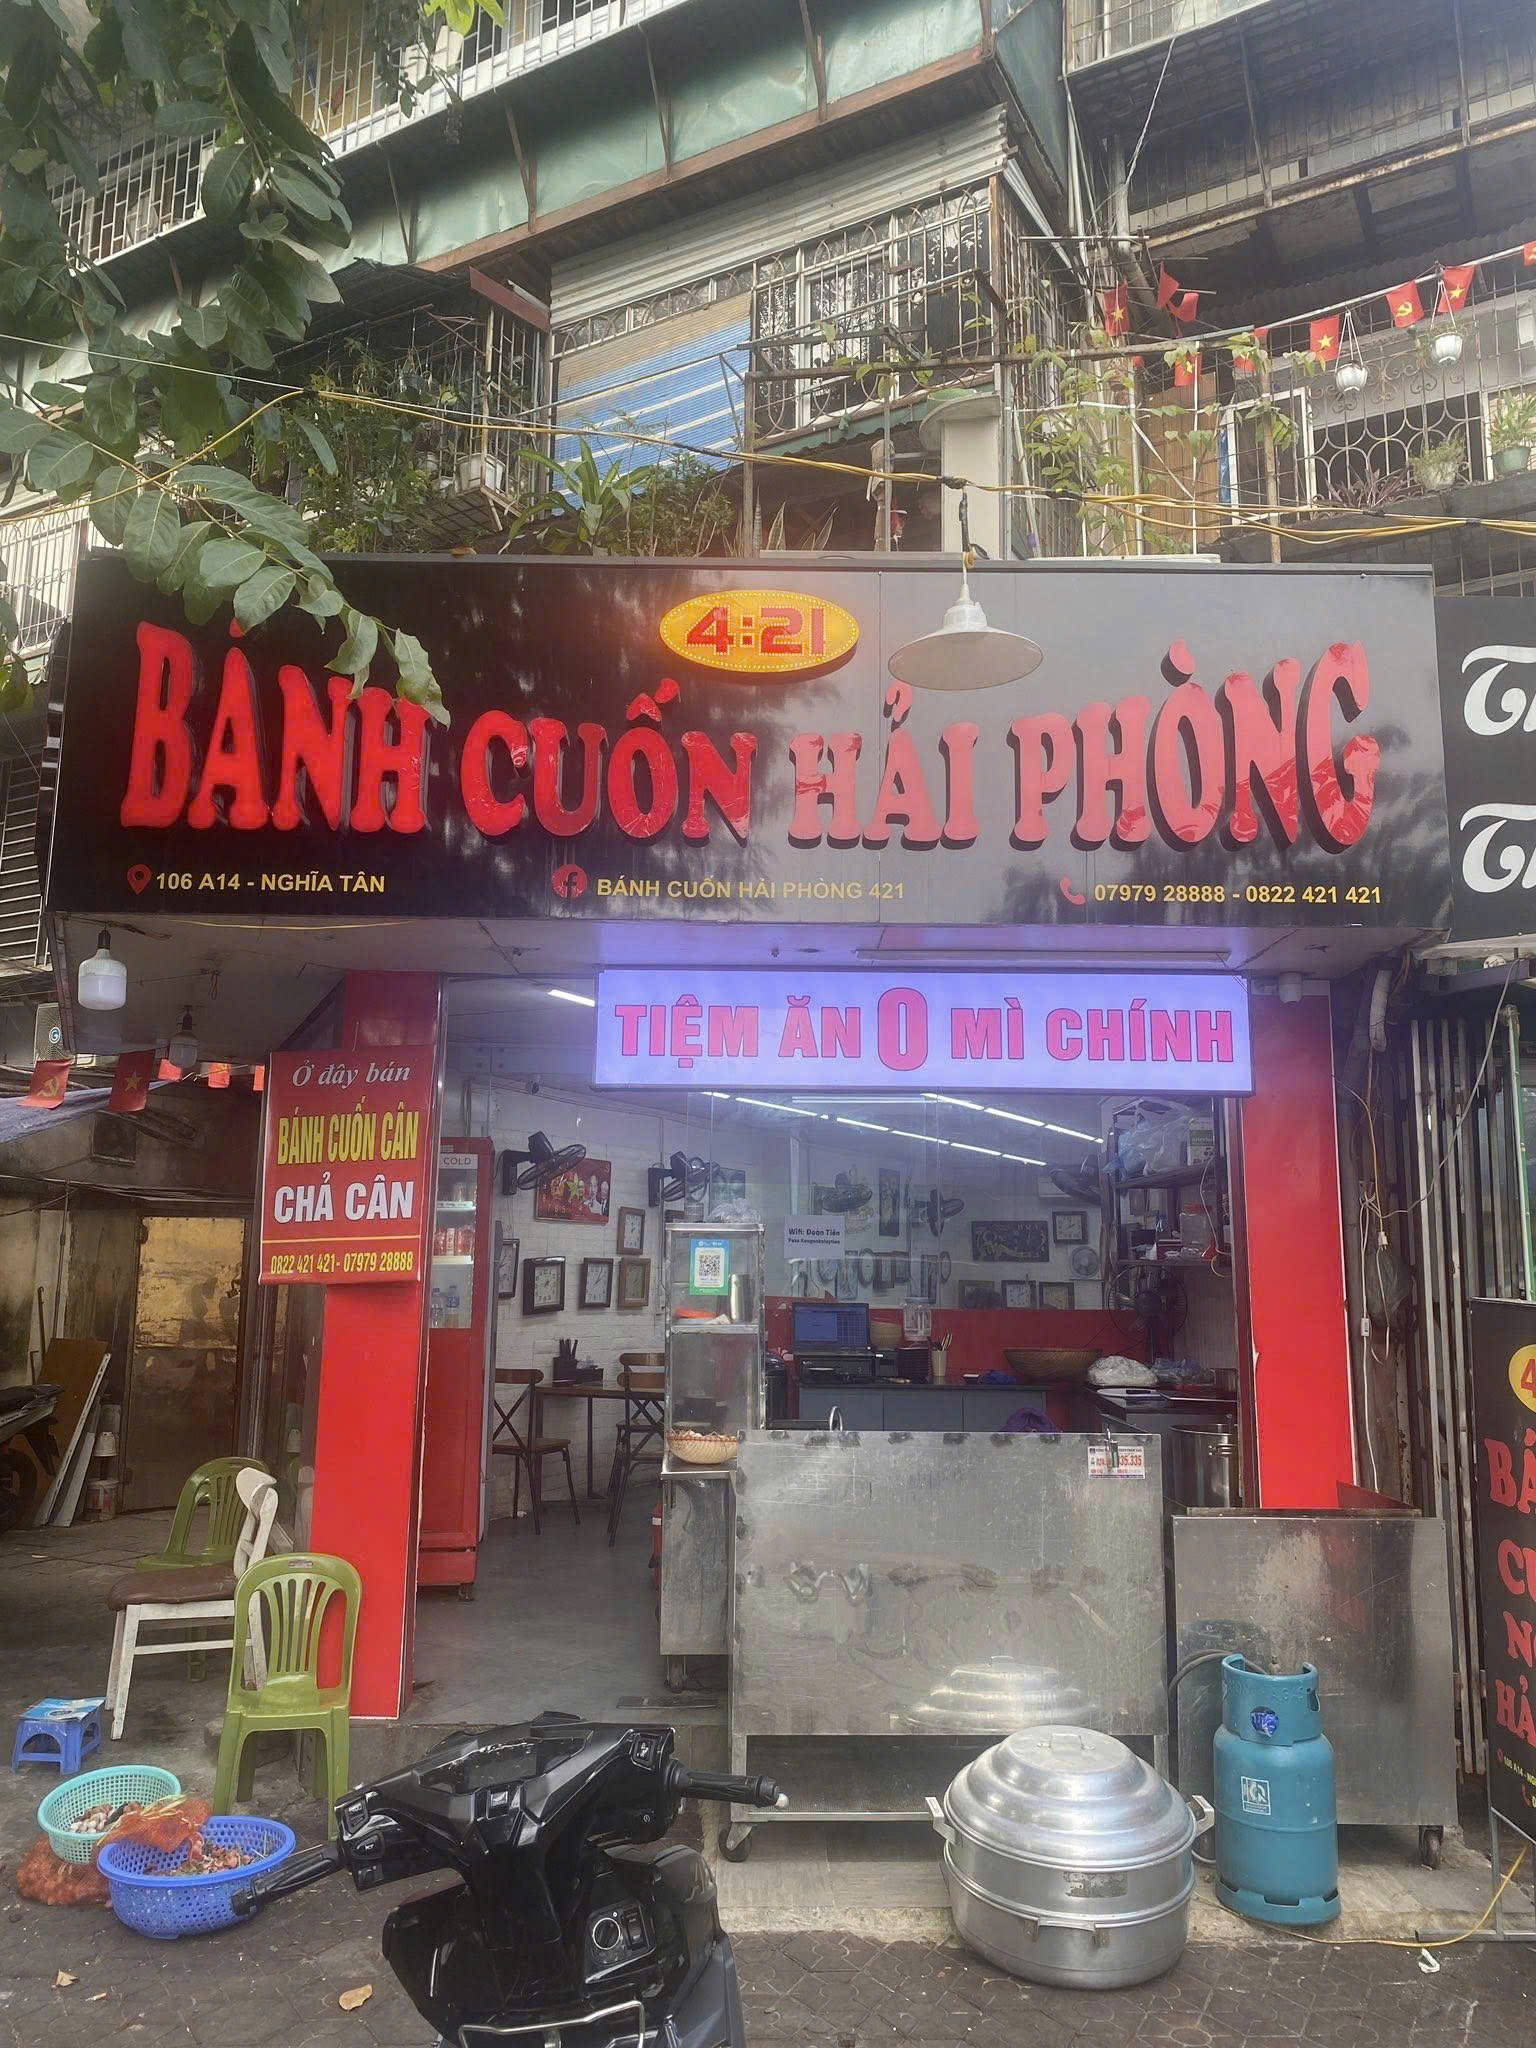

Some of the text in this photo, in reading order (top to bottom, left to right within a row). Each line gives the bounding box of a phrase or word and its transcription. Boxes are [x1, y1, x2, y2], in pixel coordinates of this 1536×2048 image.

[685, 605, 826, 656] 4:21
[120, 617, 1381, 847] BÁNH CUỐN HẢI PHÒNG
[156, 873, 193, 890] 106
[199, 873, 240, 890] A14
[261, 870, 333, 892] NGHĨA
[340, 870, 386, 893] TÂN
[597, 875, 904, 899] BÁNH CUỐN HẢI PHÒNG 421
[1094, 885, 1157, 901] 07979
[1163, 885, 1226, 902] 28888
[1246, 885, 1296, 903] 0822
[1302, 886, 1337, 903] 421
[1345, 887, 1382, 904] 421
[615, 994, 759, 1068] TIỆM
[778, 995, 861, 1058] ĂN
[951, 997, 1025, 1059] MÌ
[1046, 998, 1234, 1062] CHÍNH
[292, 1059, 411, 1089] Ở đây bán
[278, 1095, 419, 1165] BÁNH CUỐN CÂN
[443, 1157, 471, 1166] COLD
[274, 1171, 414, 1224] CHẢ CÂN
[271, 1255, 295, 1274] 0822
[297, 1255, 313, 1273] 421
[344, 1252, 377, 1272] 07979
[379, 1251, 414, 1271] 28888
